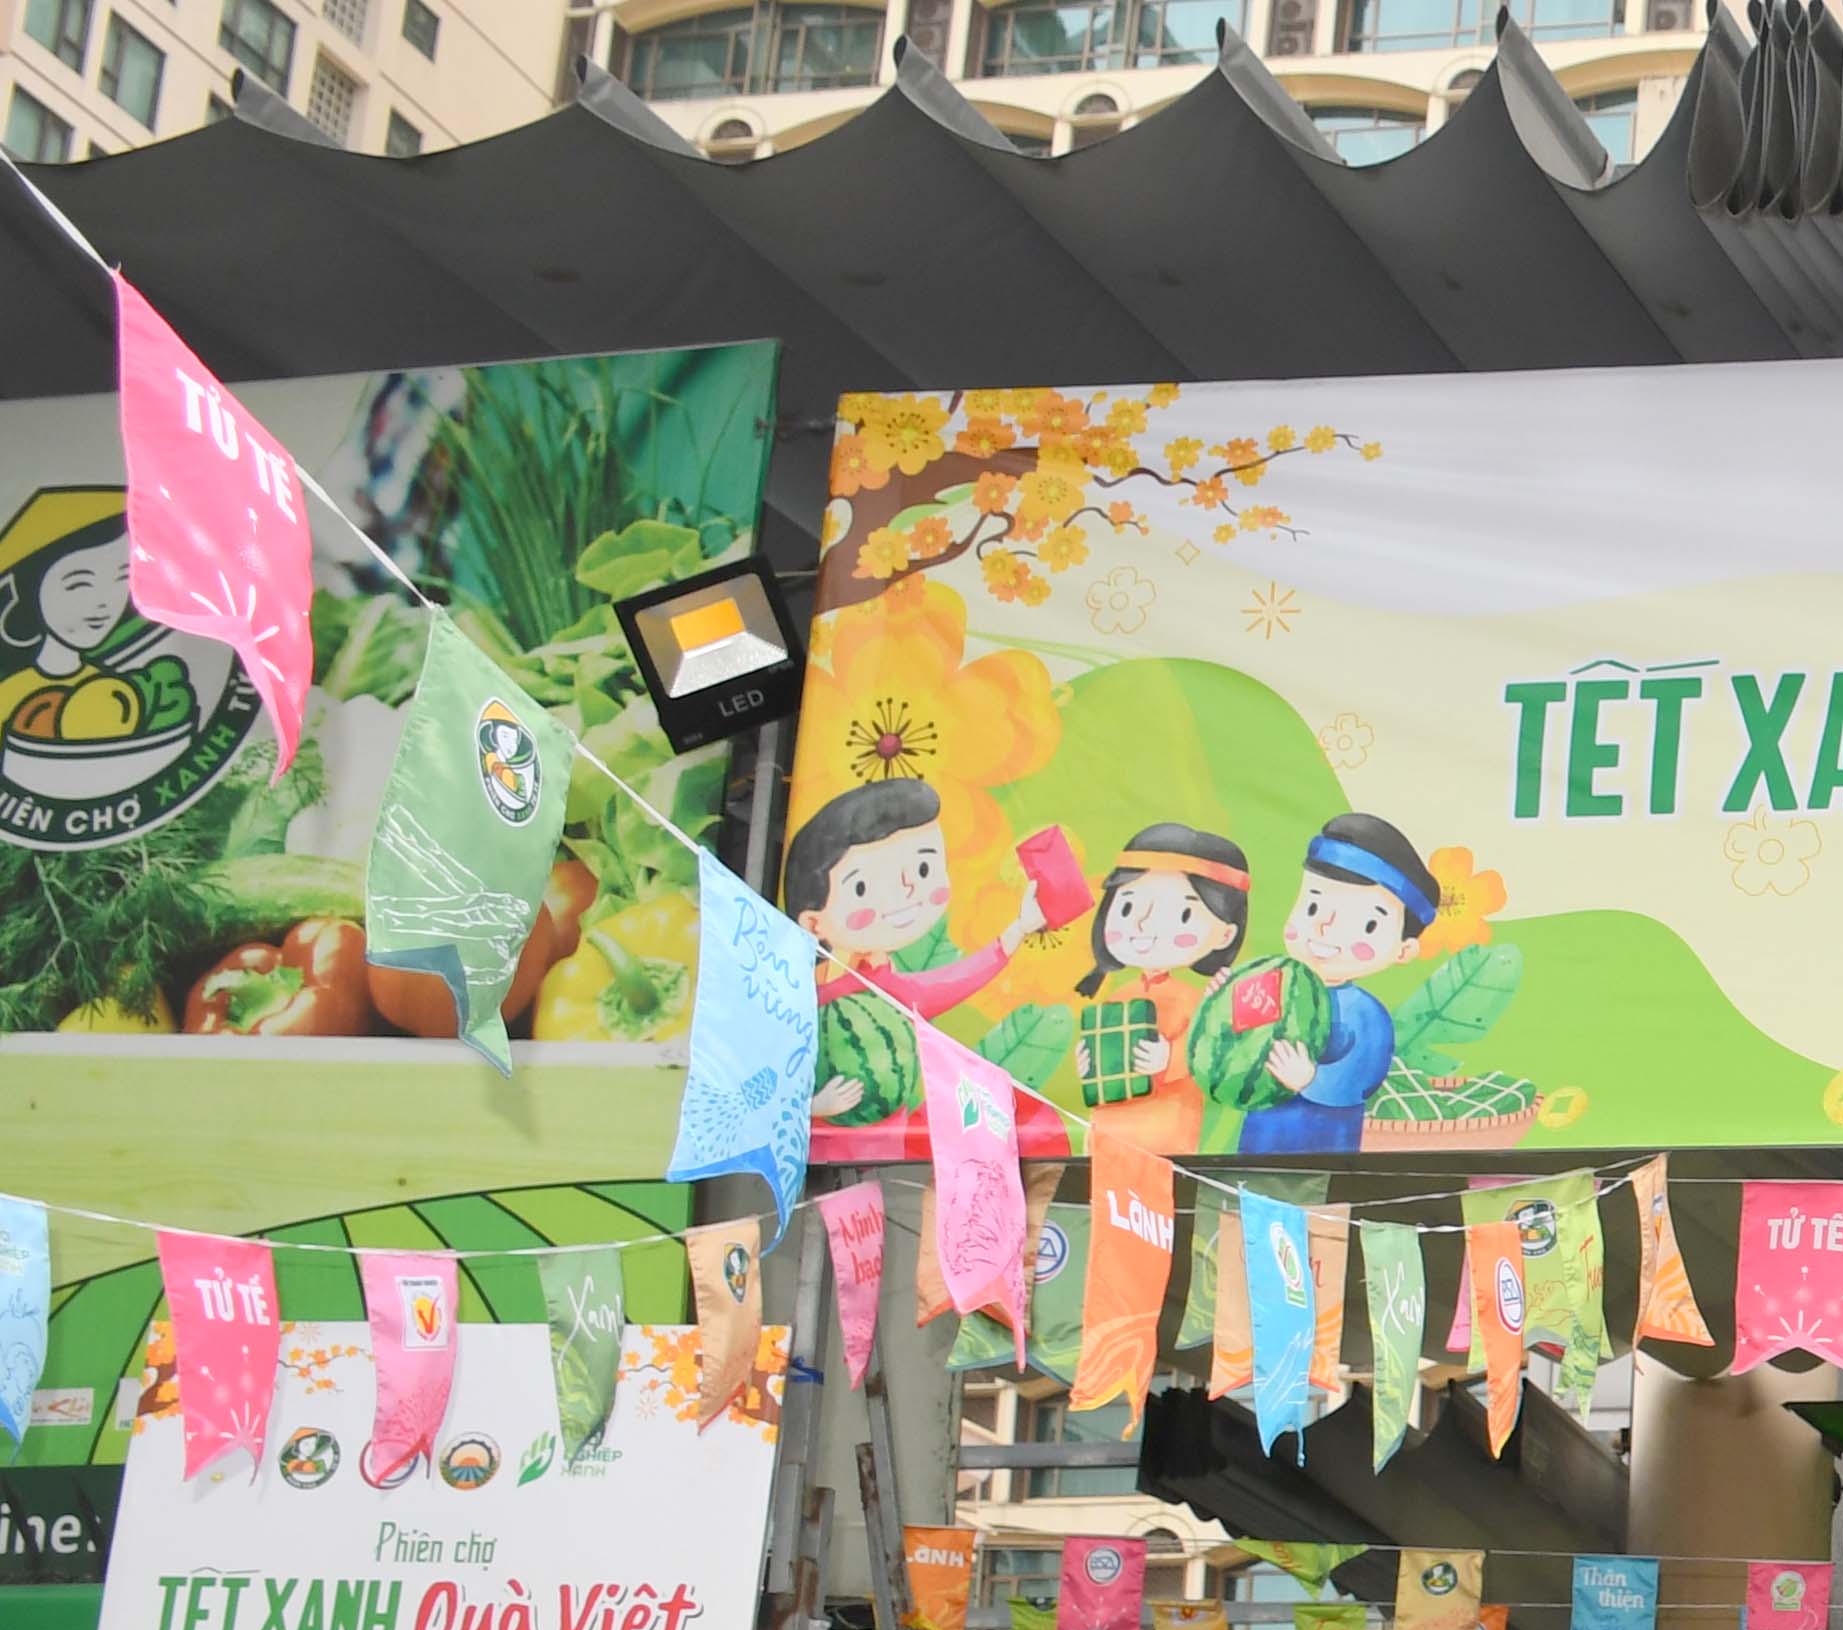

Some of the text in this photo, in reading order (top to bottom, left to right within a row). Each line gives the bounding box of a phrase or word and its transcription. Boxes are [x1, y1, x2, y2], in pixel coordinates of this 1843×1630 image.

[174, 366, 297, 524] TỬ TẾ
[718, 689, 764, 717] LED
[156, 723, 236, 806] XANH
[1503, 659, 1719, 819] TẾT
[1766, 1207, 1805, 1253] TỬ
[194, 1266, 271, 1326] TỬ TẾ
[376, 1521, 498, 1571] Phiên chợ
[1581, 1565, 1628, 1589] Thân
